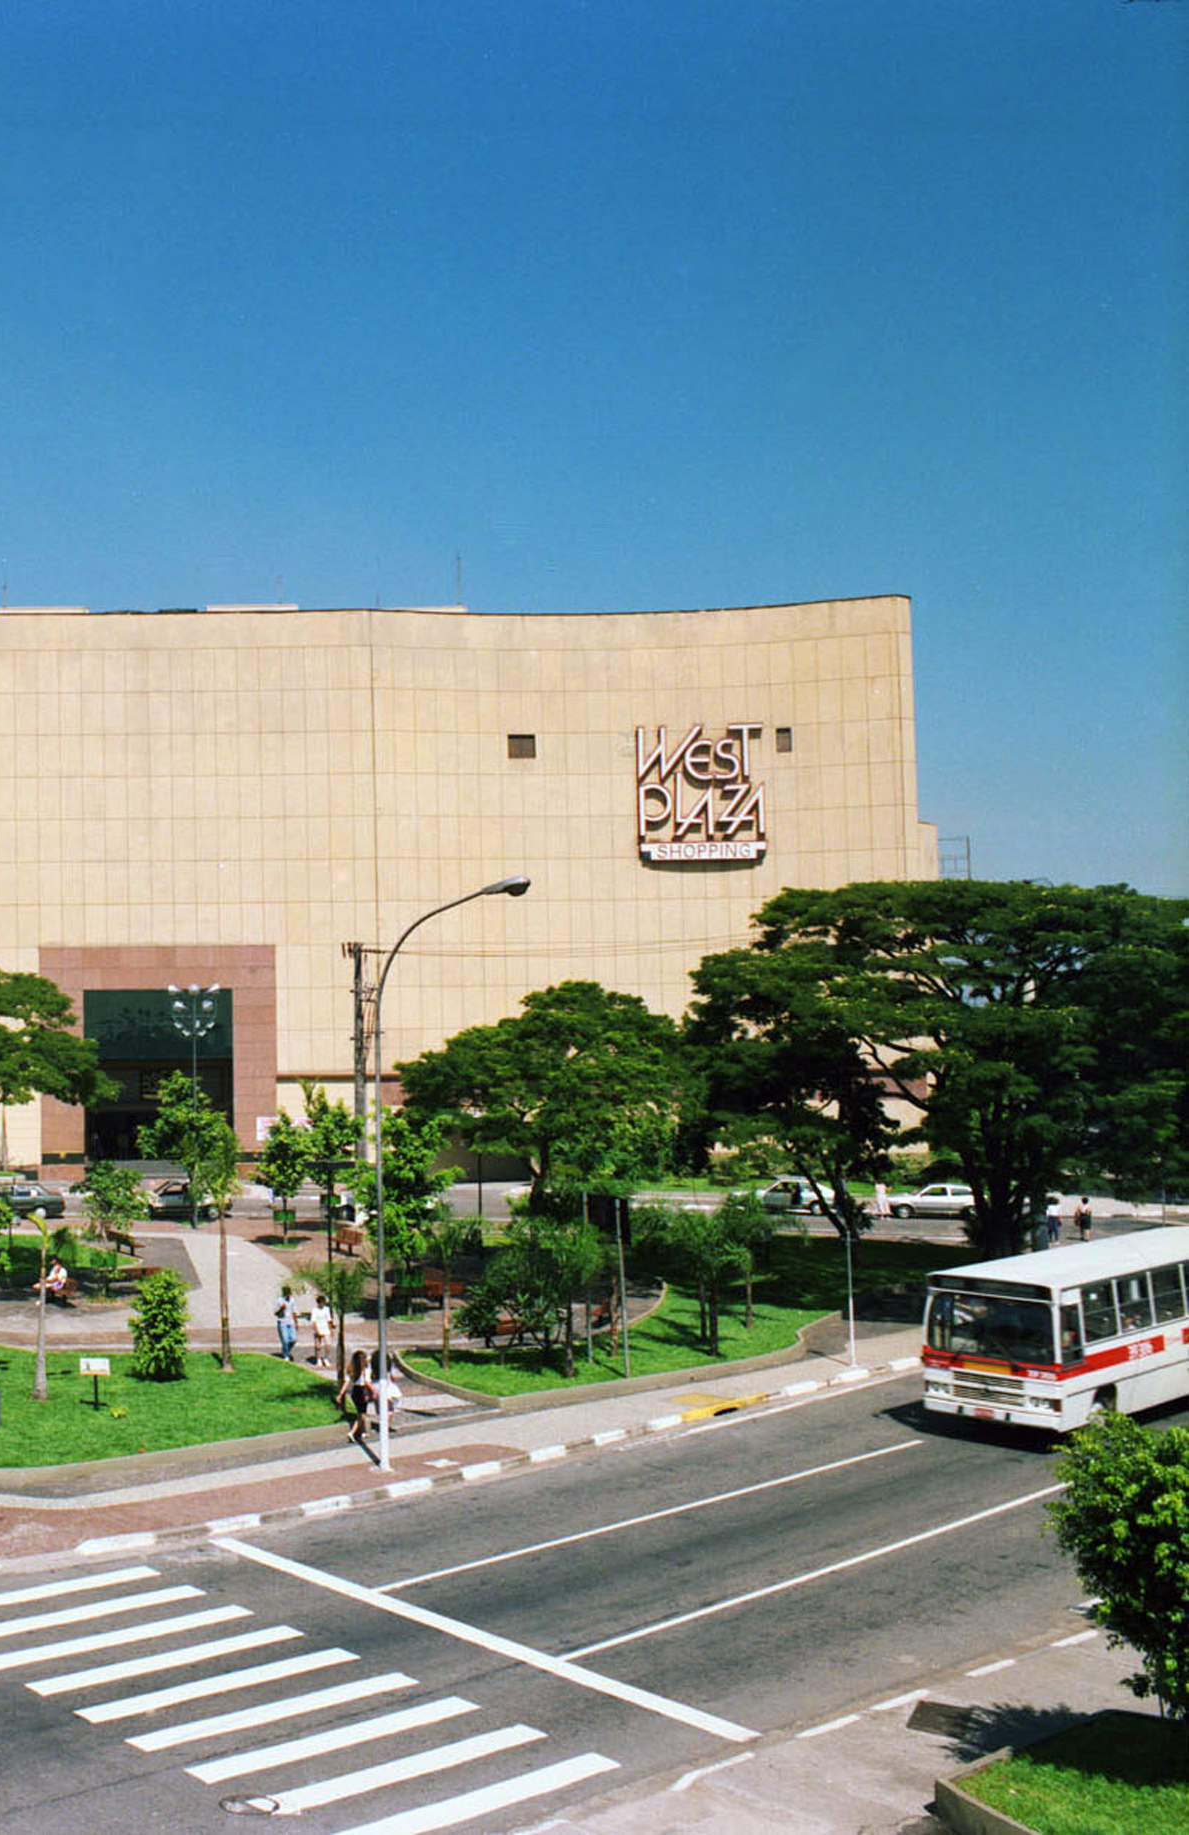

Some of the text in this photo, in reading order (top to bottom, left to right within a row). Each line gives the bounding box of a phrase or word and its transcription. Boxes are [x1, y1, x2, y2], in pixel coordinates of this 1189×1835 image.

[636, 722, 763, 783] WEST
[638, 773, 764, 836] PLAZA
[656, 843, 751, 859] SHOPPING
